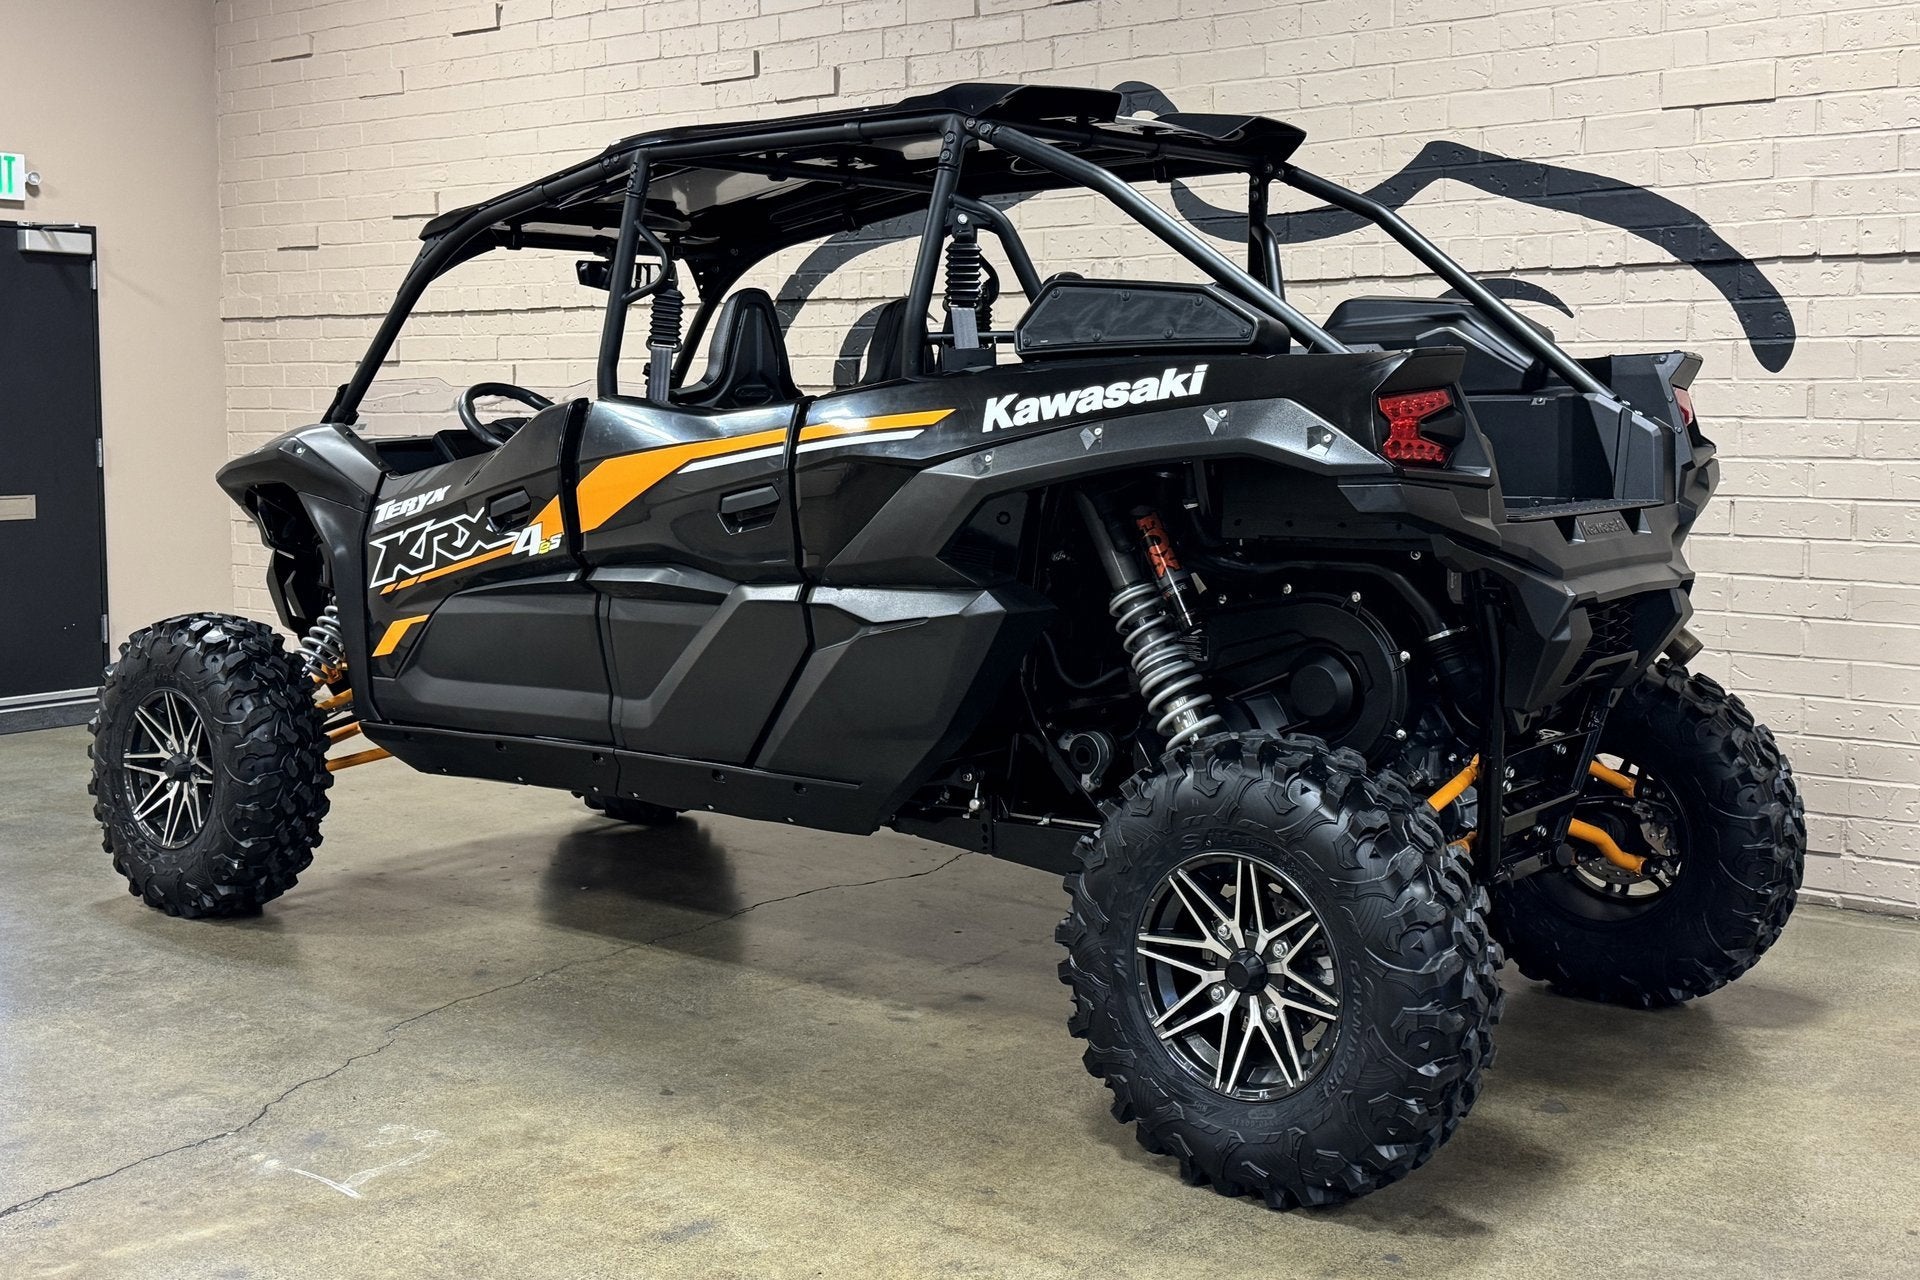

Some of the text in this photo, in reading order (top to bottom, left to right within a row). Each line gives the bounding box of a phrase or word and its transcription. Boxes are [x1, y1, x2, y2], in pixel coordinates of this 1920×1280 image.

[981, 364, 1209, 433] Kawasaki
[369, 507, 518, 589] KRX
[1136, 511, 1182, 580] FOX
